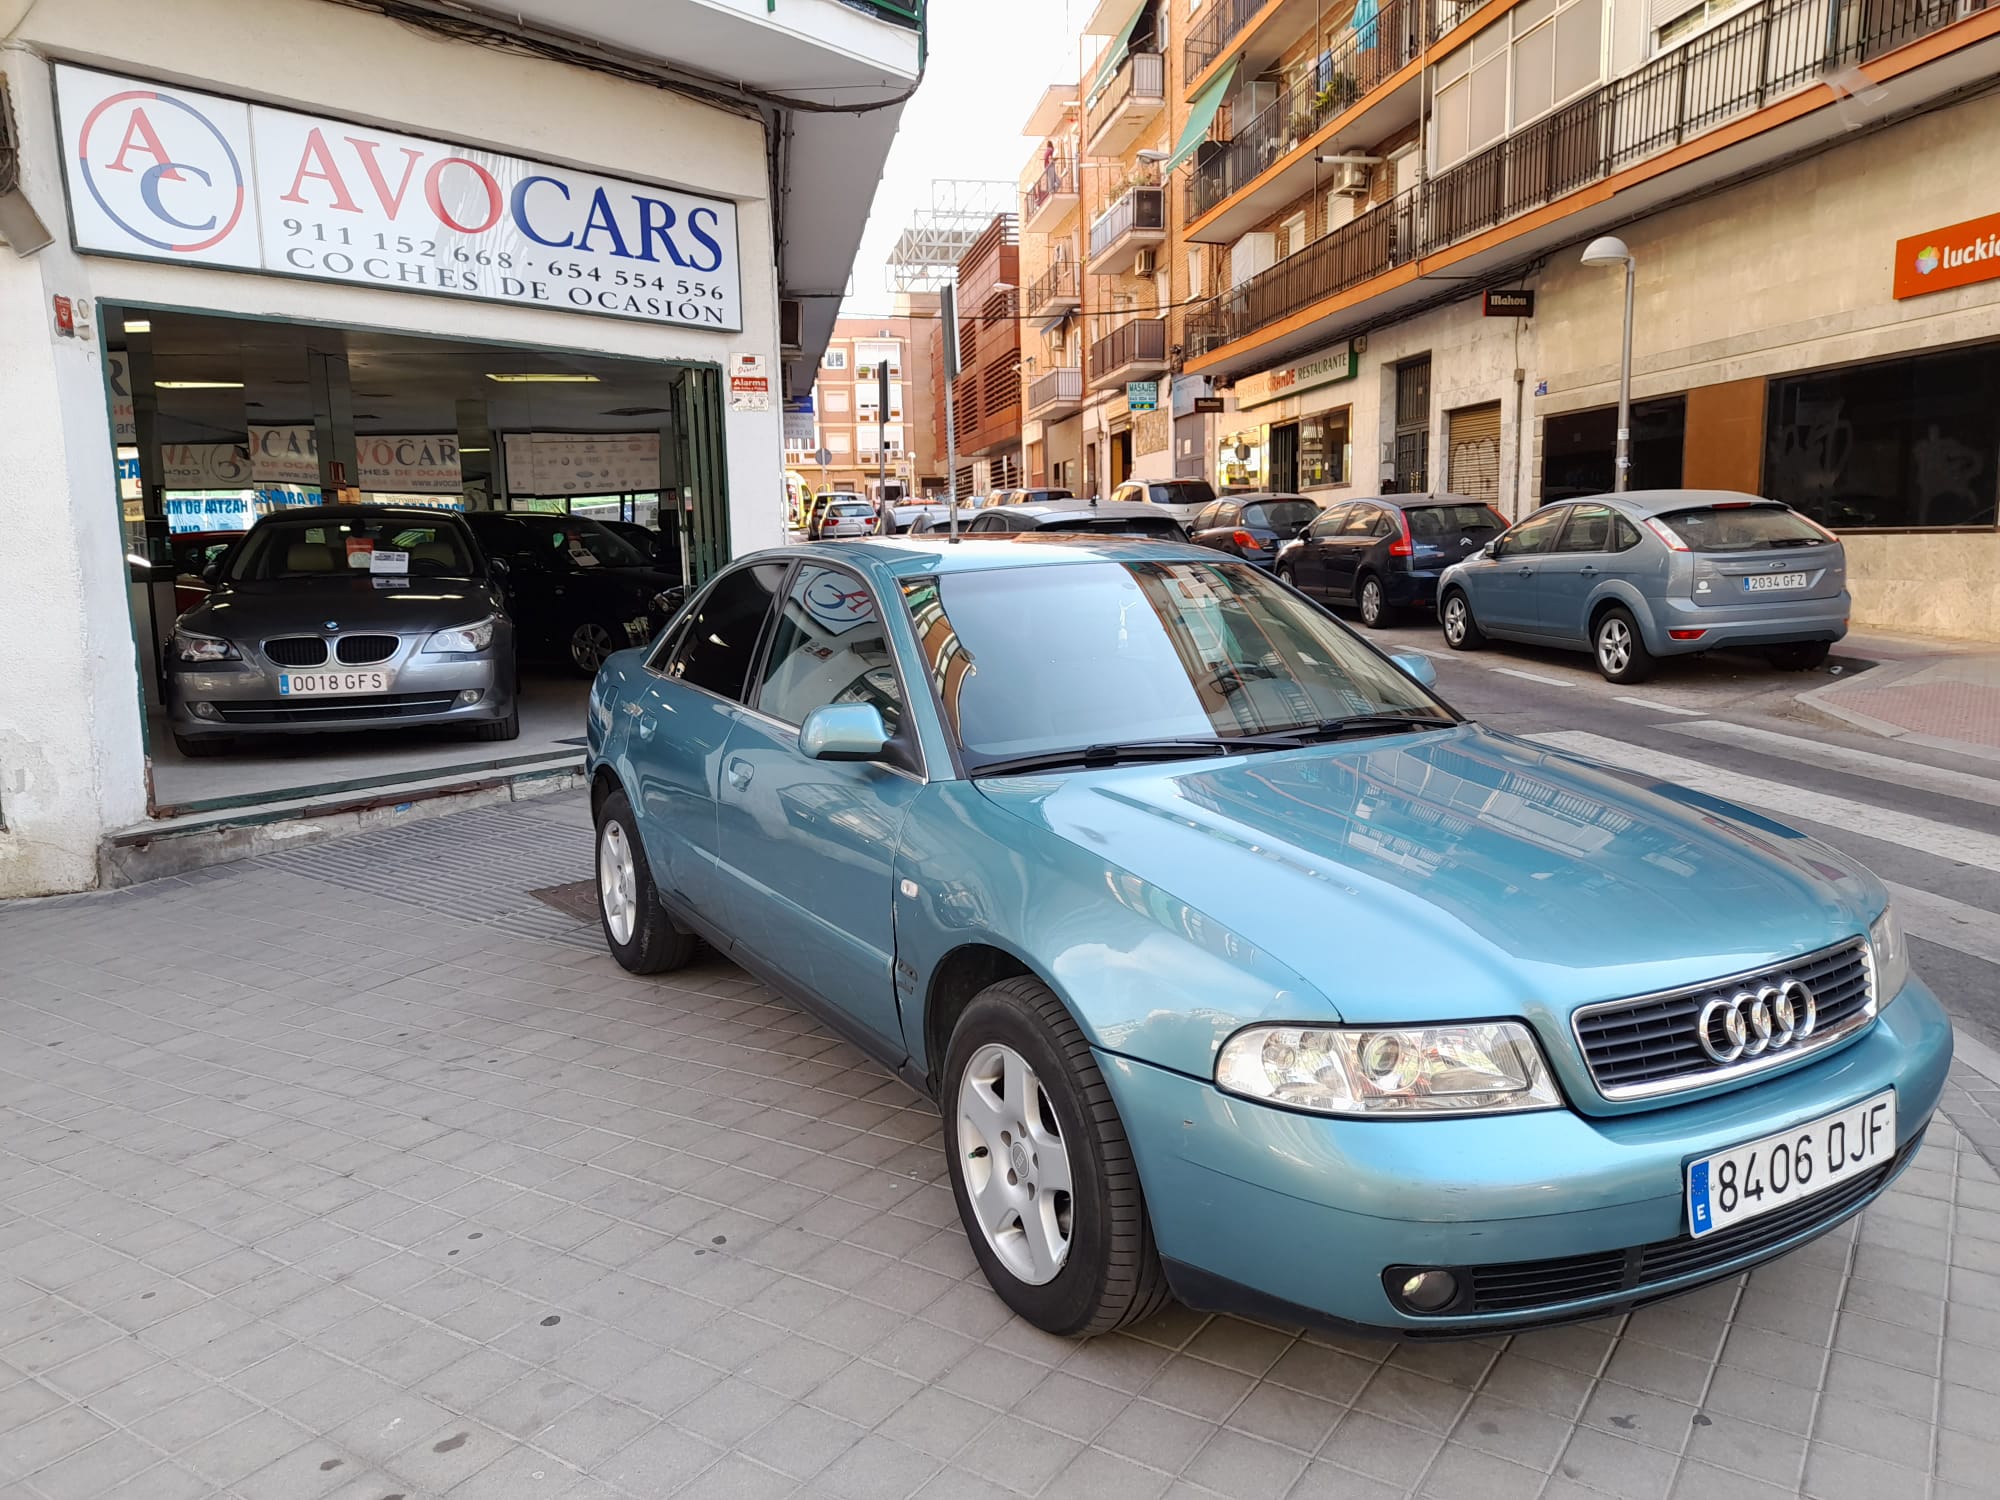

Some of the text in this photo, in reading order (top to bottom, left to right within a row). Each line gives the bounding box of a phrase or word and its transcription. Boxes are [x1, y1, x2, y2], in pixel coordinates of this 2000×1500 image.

[280, 127, 723, 273] AVOCARS
[283, 218, 724, 301] 911 152 668 654 554 556
[286, 247, 724, 324] COCHES DE OCASIÓN
[1490, 295, 1527, 306] Mahou
[1298, 352, 1347, 380] RESTAURANTE
[733, 378, 766, 386] Alarma
[1129, 383, 1157, 392] MASAJES
[1751, 574, 1804, 589] 2034 GFZ
[293, 673, 383, 691] 0018 GFS
[1696, 1103, 1887, 1221] E 8406 DJF
